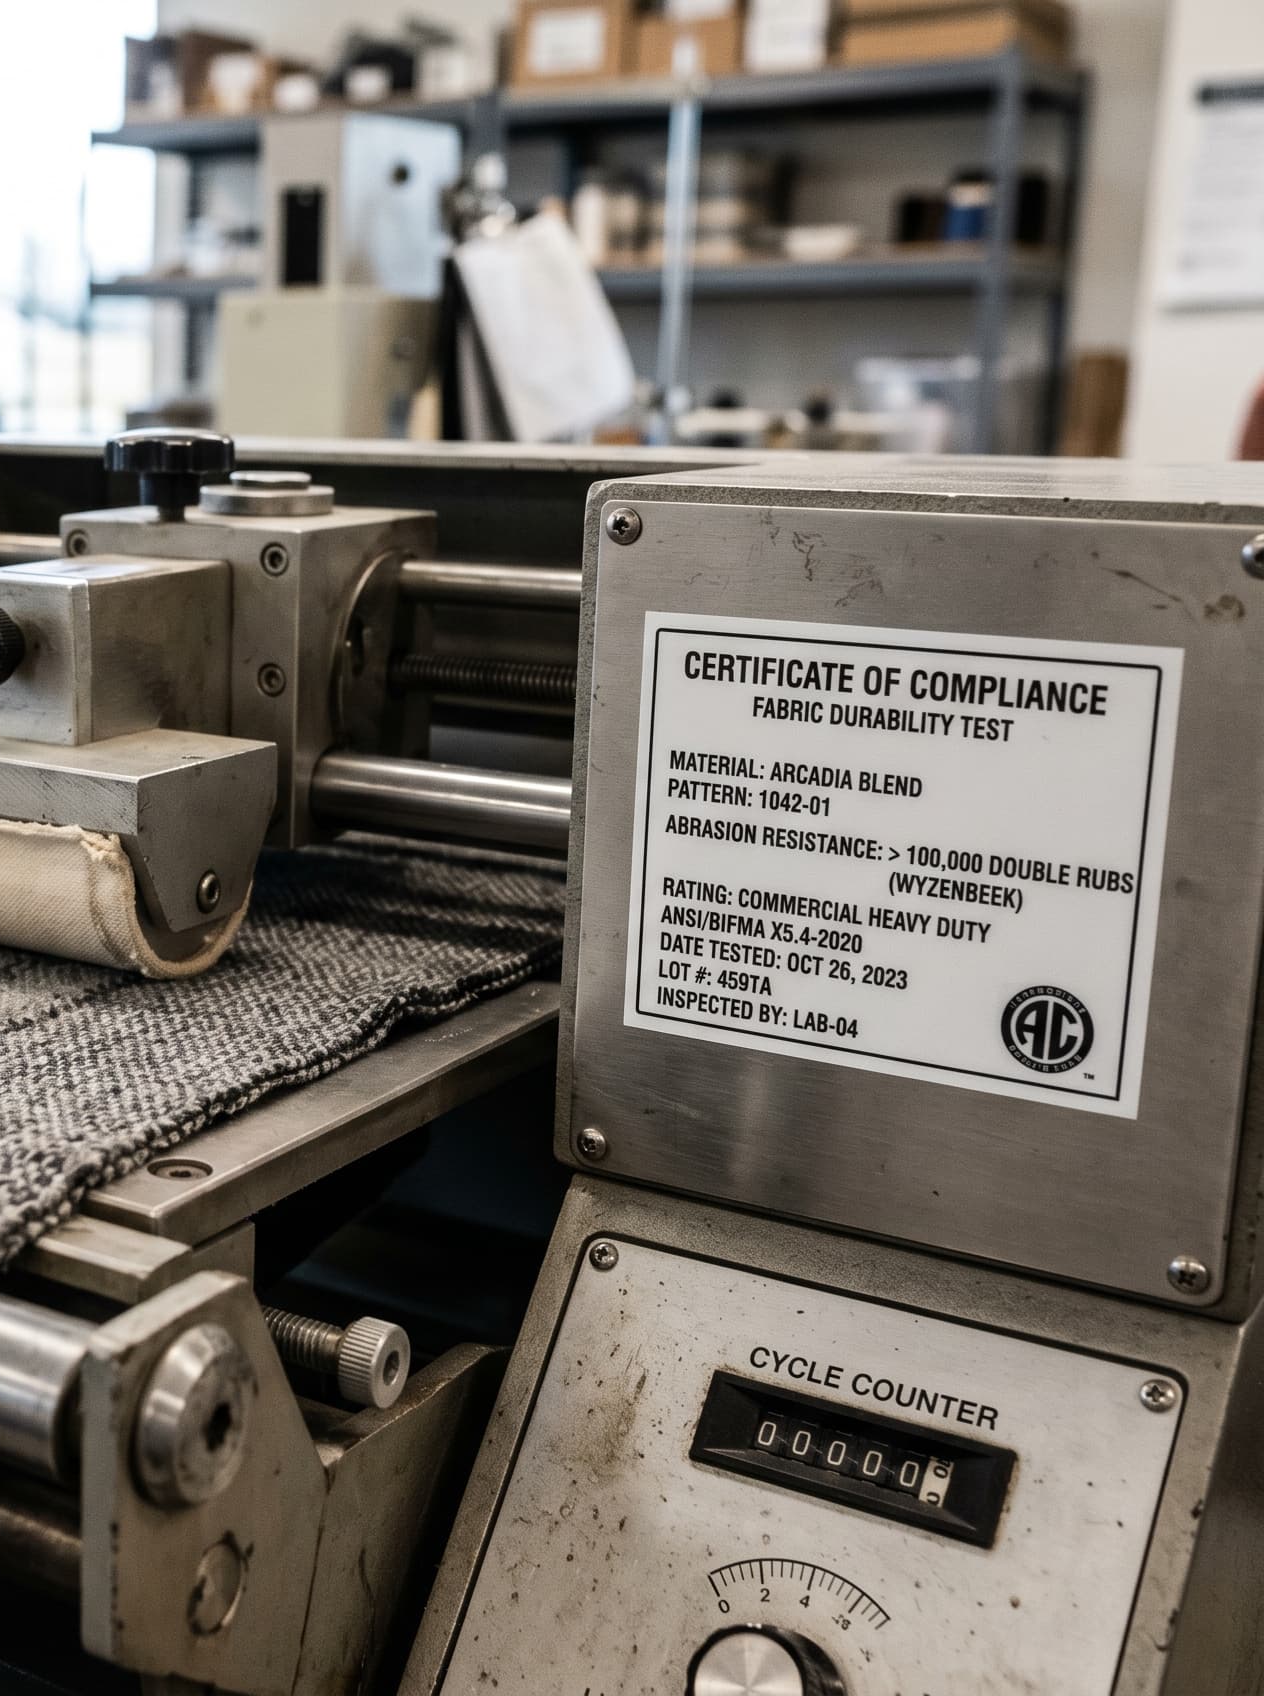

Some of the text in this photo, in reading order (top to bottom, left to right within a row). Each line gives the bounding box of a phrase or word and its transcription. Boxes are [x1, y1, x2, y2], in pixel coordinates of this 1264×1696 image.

[685, 651, 1108, 715] CERTIFICATE OF COMPLIANCE
[753, 696, 1014, 741] FABRIC DURABILITY TEST
[668, 778, 829, 816] PATTERN: 1042-01
[670, 751, 922, 797] MATERIAL: ARCADIA BLEND
[666, 815, 1133, 893] ABRASION RESISTANCE: > 100,000 DOUBLE RUBS
[663, 877, 991, 943] RATING: COMMERCIAL HEAVY DUTY
[889, 872, 1022, 914] (WYZENBEEK)
[661, 906, 862, 953] ANSI/BIFMA X5.4-2020
[659, 959, 771, 996] LOT #: 459TA
[661, 932, 907, 989] DATE TESTED: OCT 26, 2023
[658, 987, 858, 1038] INSPECTED BY: LAB-04
[749, 1346, 999, 1430] CYCLE COUNTER
[760, 1588, 771, 1603] 2
[799, 1595, 811, 1608] 4
